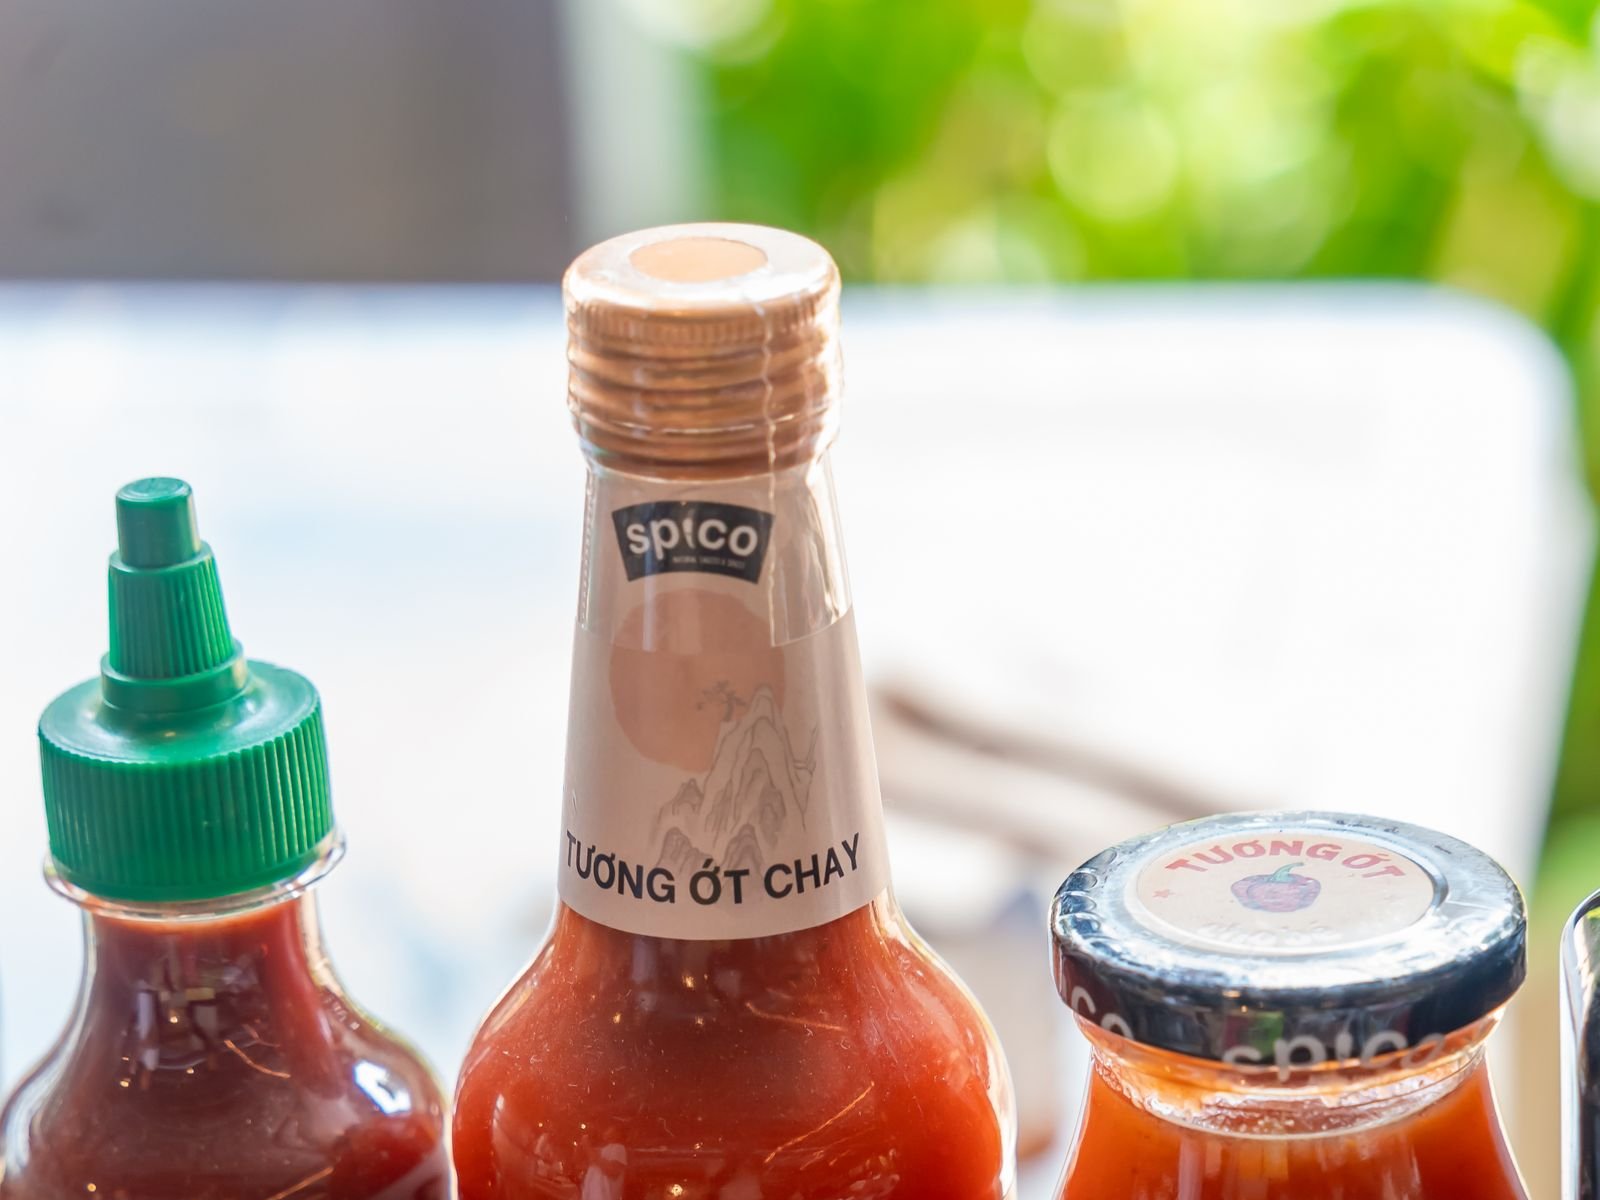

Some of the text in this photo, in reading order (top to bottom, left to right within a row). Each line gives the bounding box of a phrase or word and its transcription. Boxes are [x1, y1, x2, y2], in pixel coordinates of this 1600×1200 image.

[626, 514, 758, 561] spico
[566, 829, 861, 907] TƯƠNG ỚT CHAY
[1166, 840, 1407, 882] TƯƠNG ỚT
